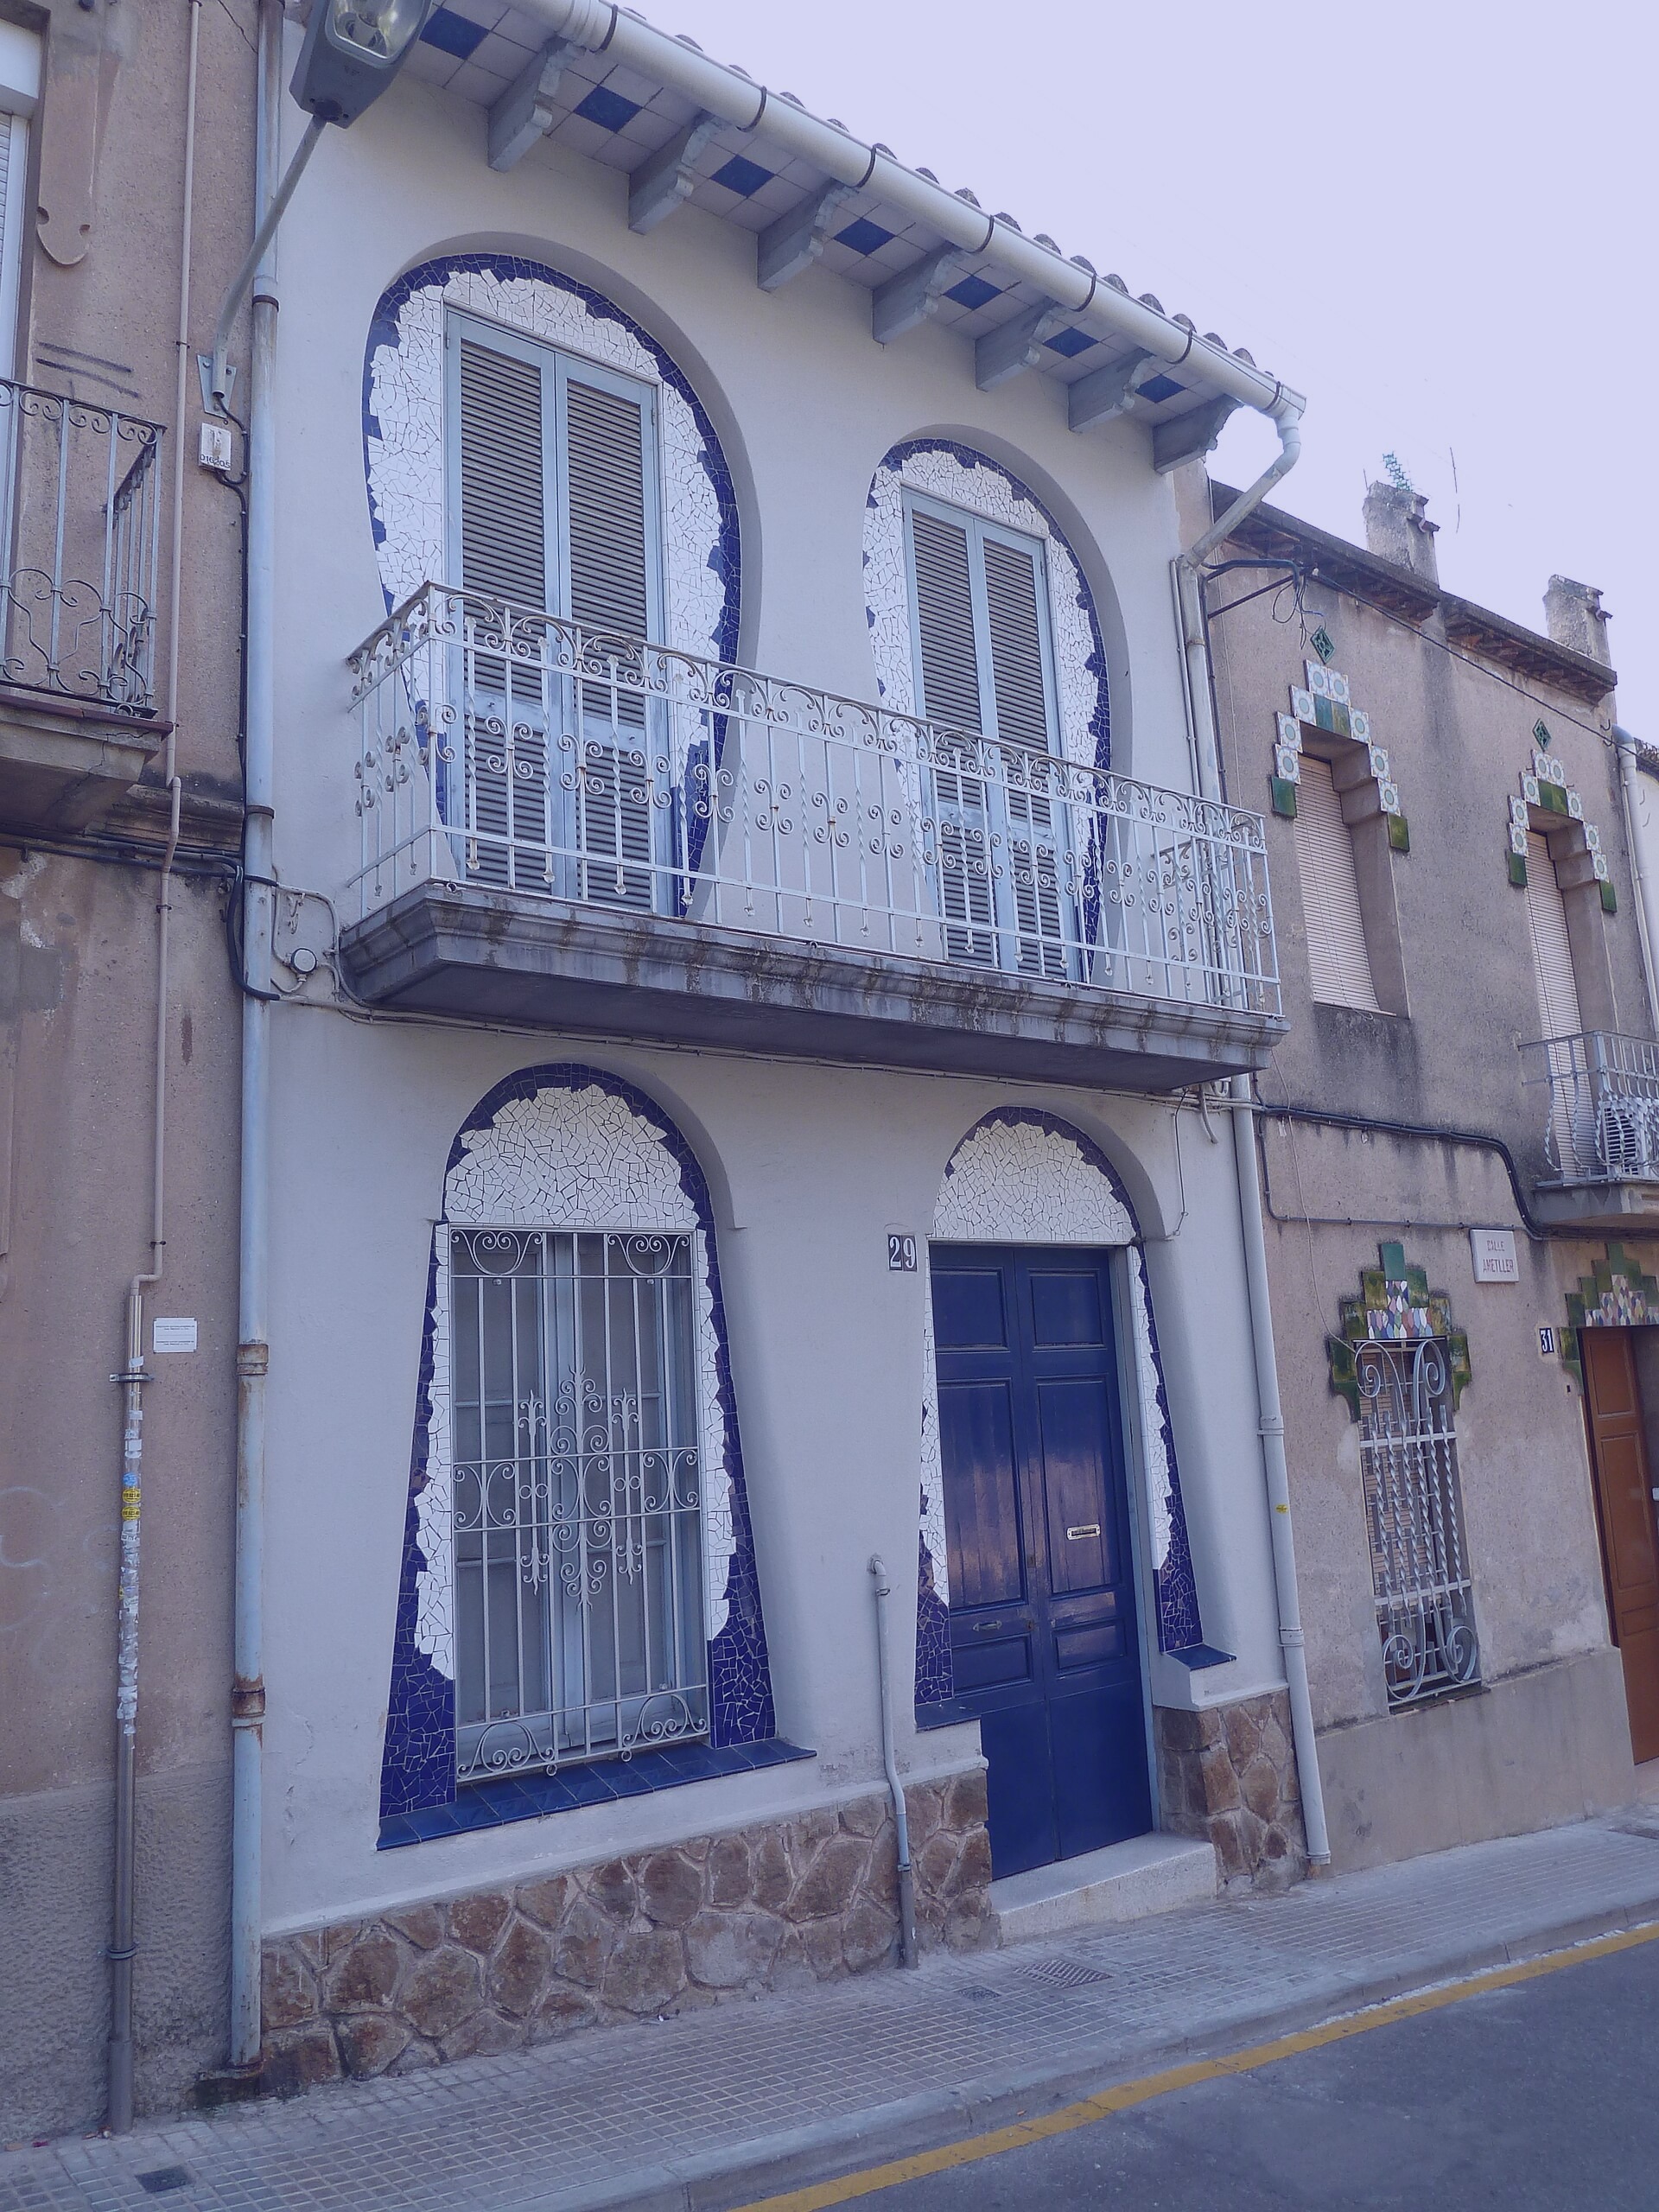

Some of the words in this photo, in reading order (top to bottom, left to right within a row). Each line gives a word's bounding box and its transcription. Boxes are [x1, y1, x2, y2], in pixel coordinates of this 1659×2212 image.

[889, 1236, 916, 1268] 29
[1483, 1258, 1515, 1273] AMETLLER
[1540, 1329, 1554, 1352] 31
